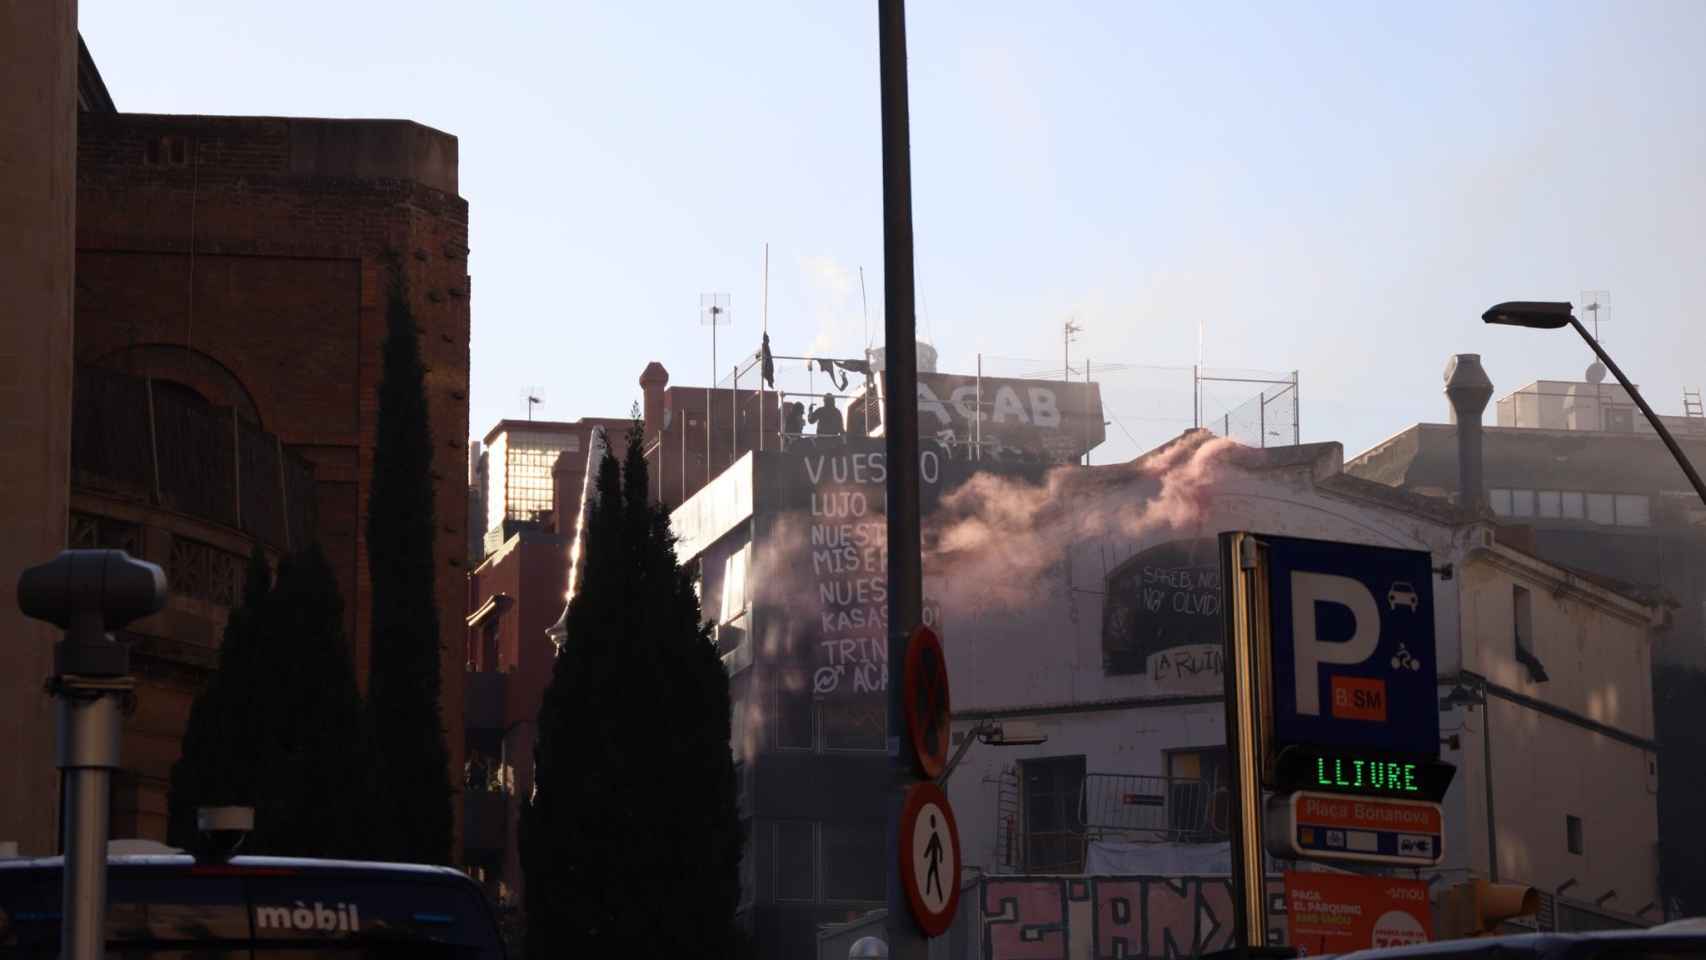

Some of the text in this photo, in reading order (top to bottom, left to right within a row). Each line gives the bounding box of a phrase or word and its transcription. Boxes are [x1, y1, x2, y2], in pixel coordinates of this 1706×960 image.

[918, 382, 1061, 428] ACAB
[804, 451, 939, 484] VUESO
[811, 492, 868, 518] LUJO
[811, 523, 888, 547] NUEST
[813, 547, 888, 576] MISE
[820, 579, 887, 606] NUES
[821, 637, 888, 665] TRIN
[1290, 570, 1382, 716] P
[852, 663, 888, 693] ACA
[1317, 757, 1419, 791] LLIURE
[1354, 803, 1428, 825] Bonanova
[256, 901, 360, 932] mòbil
